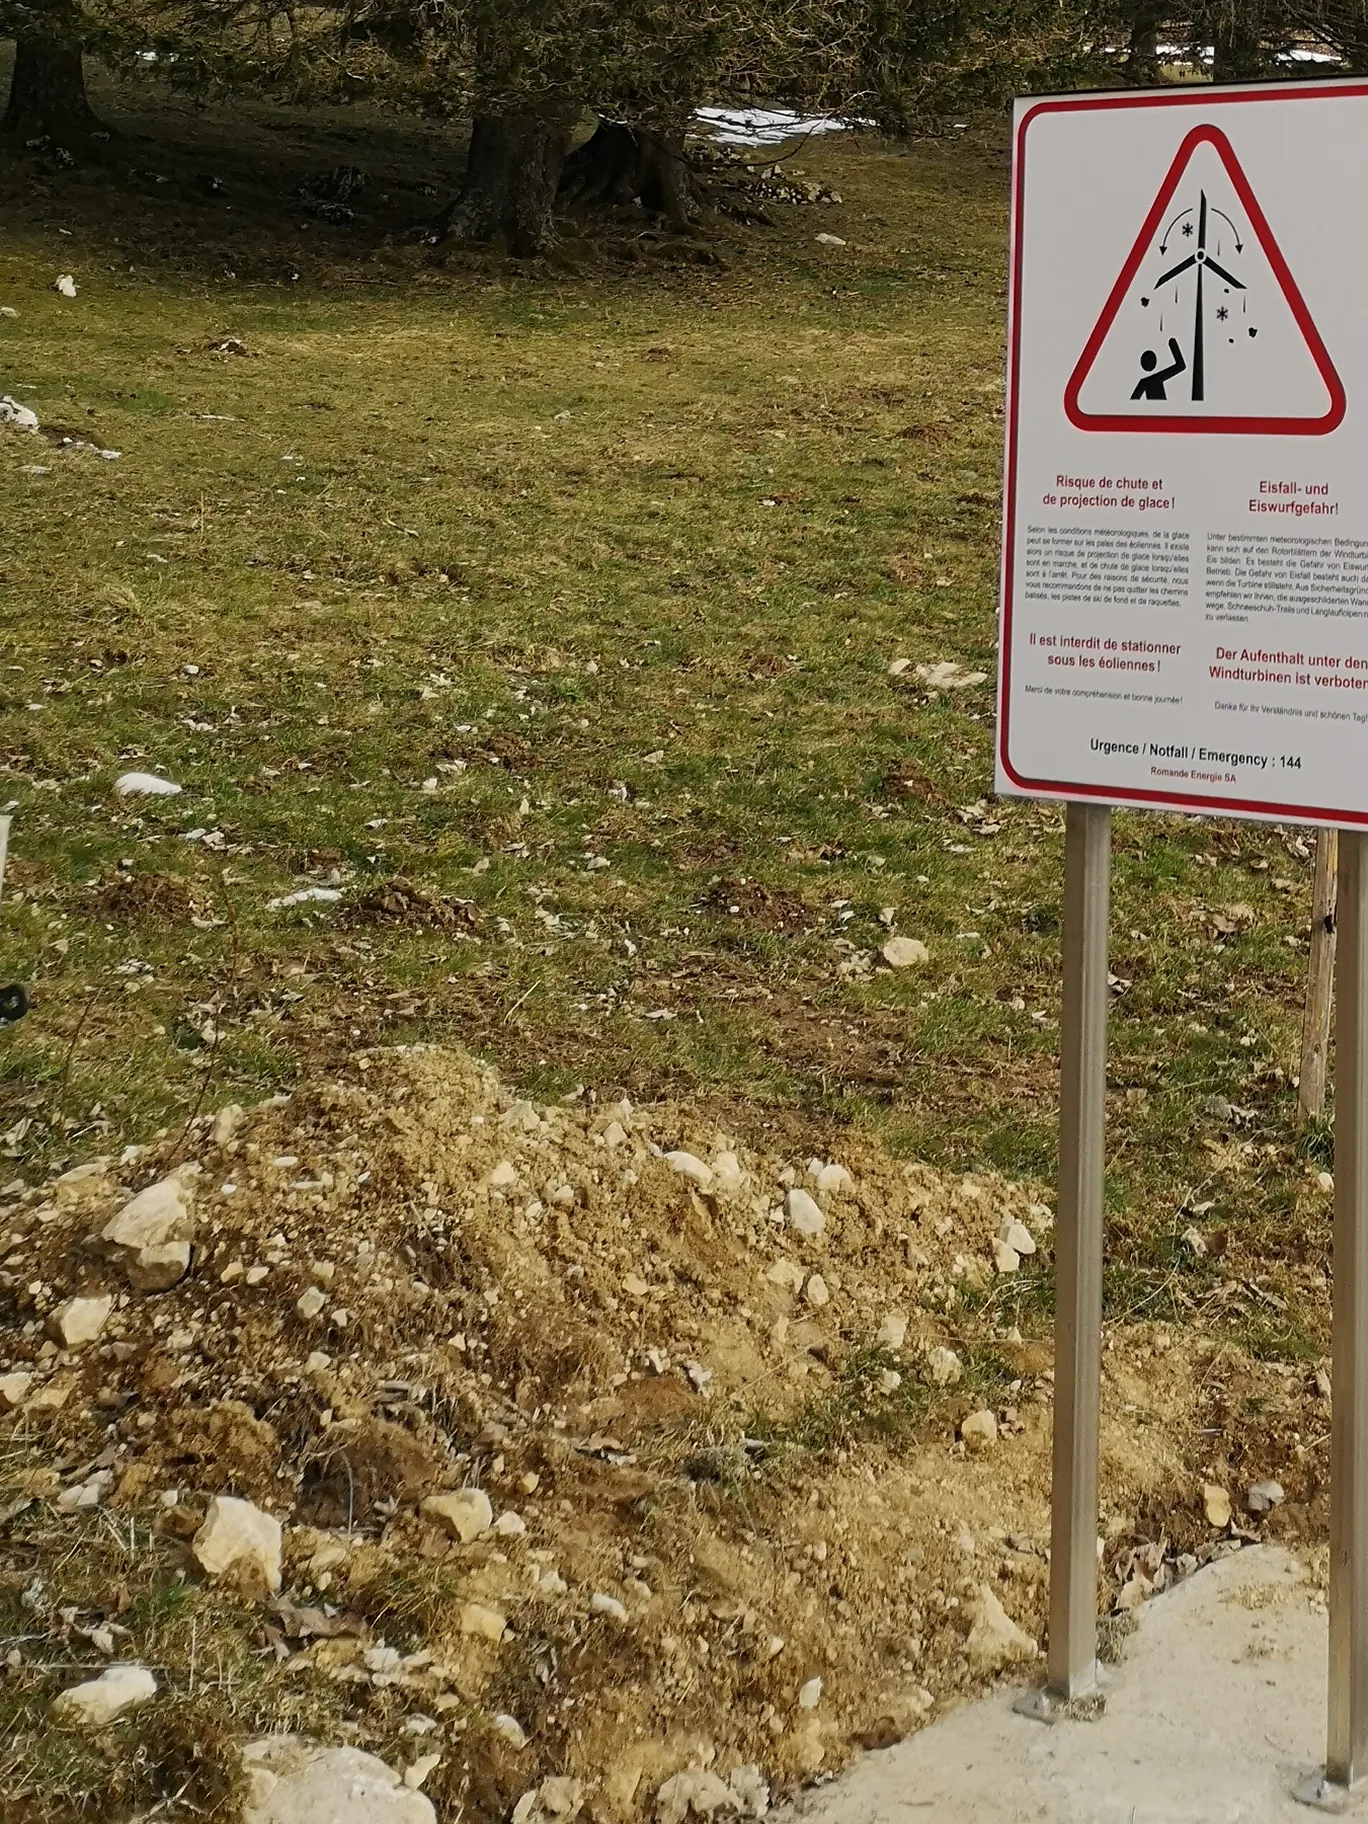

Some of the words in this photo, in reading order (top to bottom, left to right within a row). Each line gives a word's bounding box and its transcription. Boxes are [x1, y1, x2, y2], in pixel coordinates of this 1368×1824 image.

[1056, 475, 1096, 491] Risque
[1099, 476, 1113, 488] de
[1116, 477, 1149, 489] chute
[1152, 478, 1163, 490] et
[1259, 481, 1302, 494] Eisfall-
[1305, 483, 1329, 495] und
[1042, 492, 1057, 505] de
[1060, 493, 1118, 509] projection
[1121, 495, 1135, 507] de
[1249, 499, 1339, 516] Eiswurfgefahr!
[1029, 632, 1036, 645] Il
[1039, 634, 1057, 646] est
[1060, 634, 1100, 649] interdit
[1103, 637, 1118, 650] de
[1121, 640, 1181, 654] stationner
[1048, 655, 1075, 666] sous
[1079, 654, 1095, 667] les
[1216, 647, 1238, 660] Der
[1240, 648, 1304, 665] Aufenthalt
[1308, 655, 1341, 667] unter
[1344, 656, 1368, 669] den
[1209, 665, 1292, 683] Windturbinen
[1295, 672, 1311, 685] ist
[1090, 738, 1139, 754] Urgence
[1142, 742, 1146, 755] /
[1150, 743, 1188, 758] Notfall
[1191, 747, 1195, 759] /
[1199, 748, 1268, 769] Emergency
[1280, 755, 1301, 769] 144
[1150, 766, 1189, 778] Romande
[1190, 770, 1223, 783] Energie
[1224, 773, 1237, 783] SA
